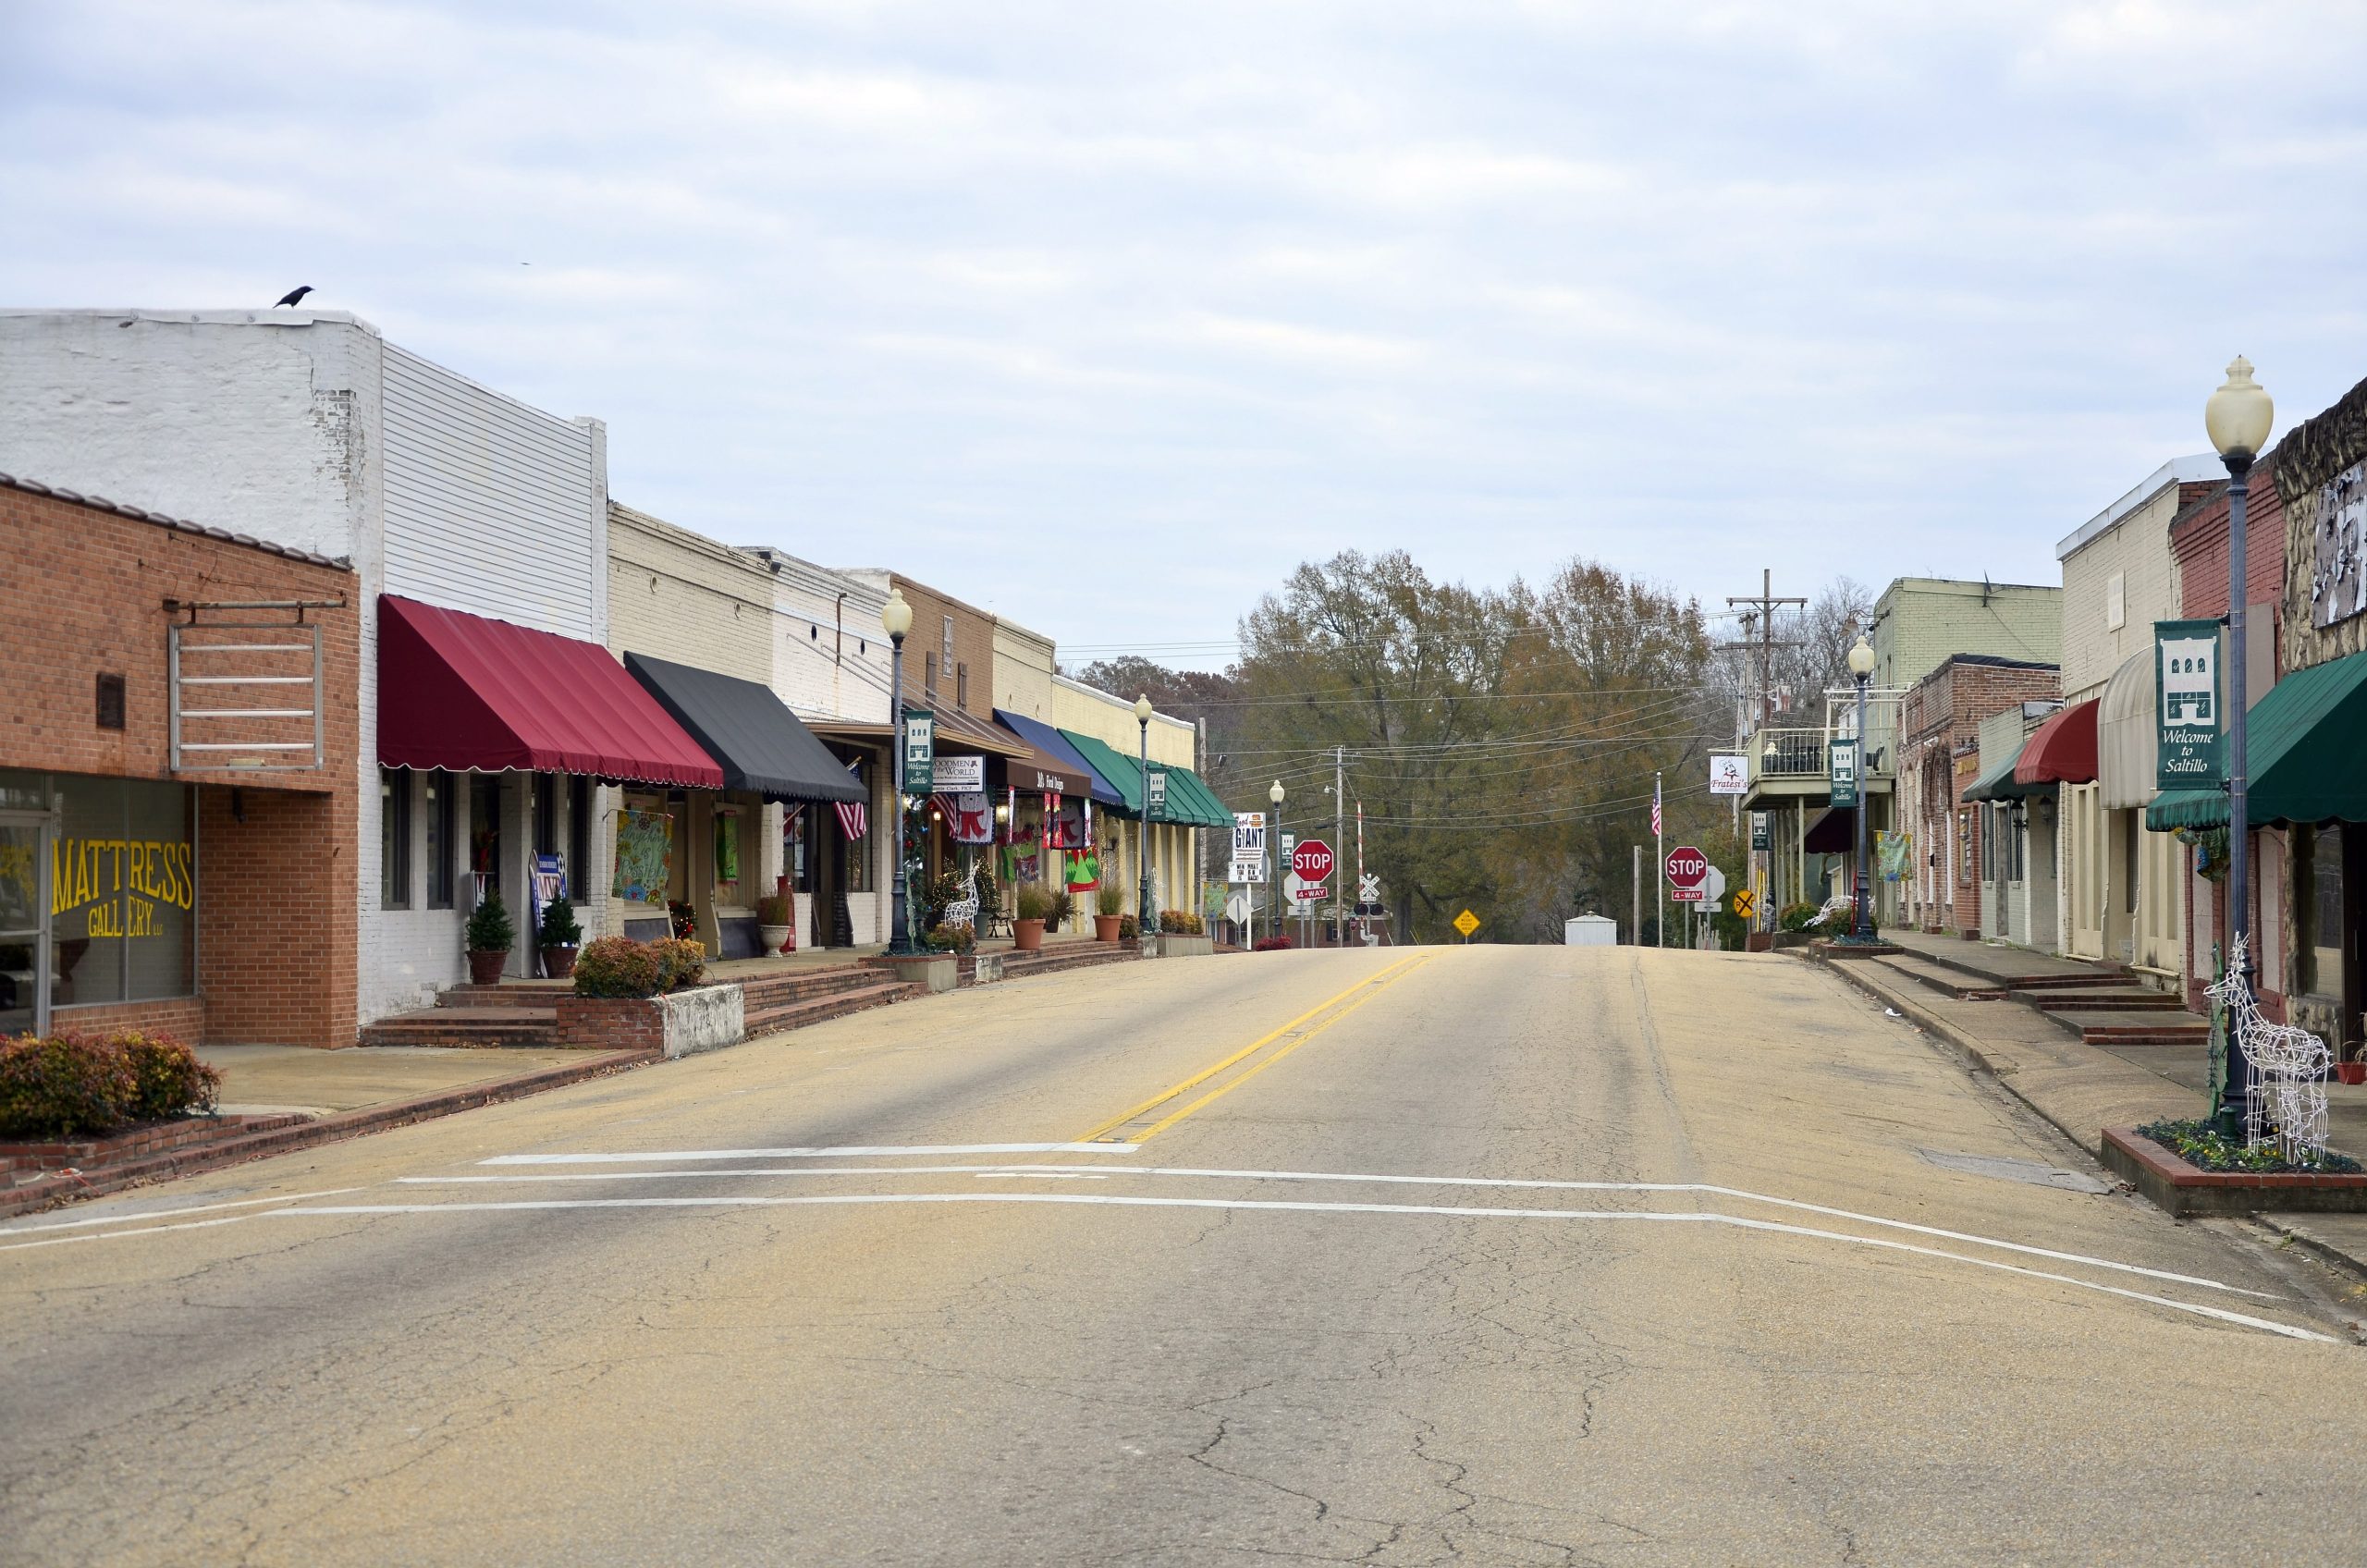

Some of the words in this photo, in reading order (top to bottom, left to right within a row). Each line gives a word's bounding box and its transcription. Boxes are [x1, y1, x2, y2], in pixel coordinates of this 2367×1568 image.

[2163, 729, 2214, 743] Welcome
[2181, 745, 2193, 756] to
[945, 766, 975, 776] WORLD
[2165, 758, 2208, 773] Saltillo
[1711, 778, 1748, 788] Fratesi's
[1294, 853, 1331, 869] STOP
[1668, 859, 1705, 876] STOP
[51, 839, 193, 915] MATTRESS
[1297, 889, 1325, 899] 4-WAY
[88, 895, 154, 937] GALLERY
